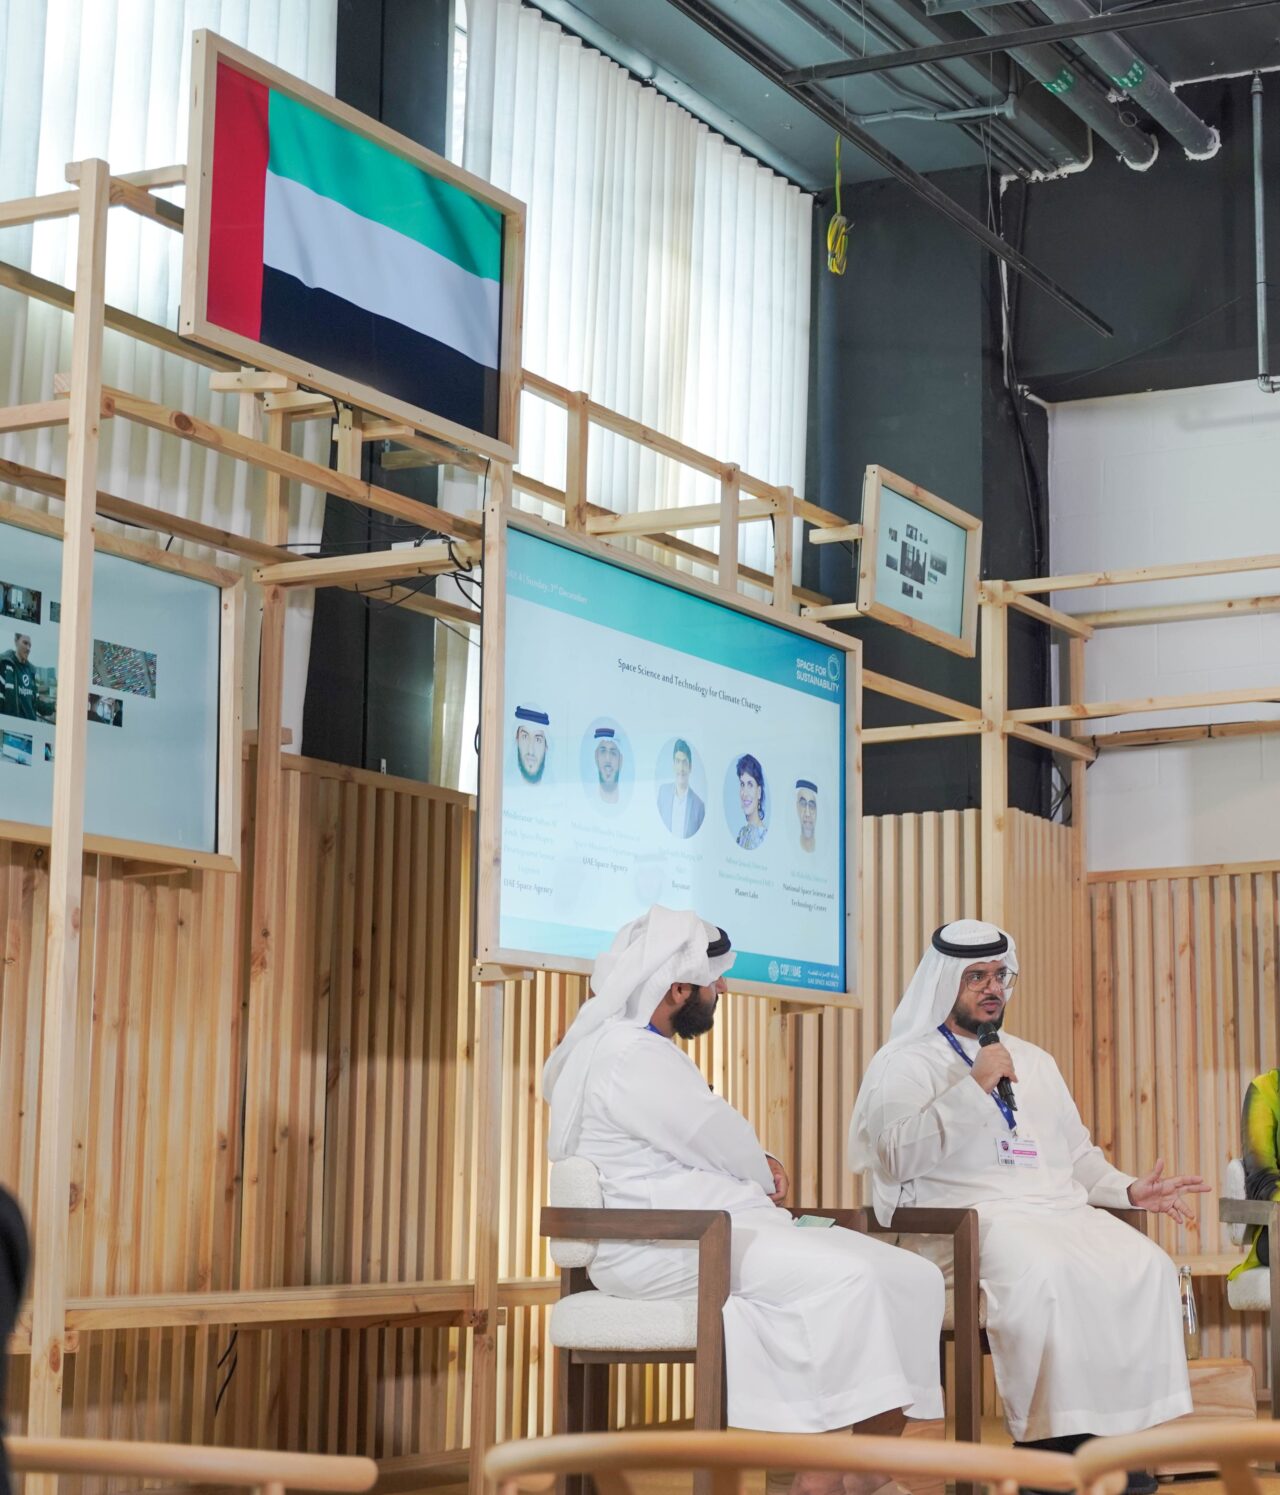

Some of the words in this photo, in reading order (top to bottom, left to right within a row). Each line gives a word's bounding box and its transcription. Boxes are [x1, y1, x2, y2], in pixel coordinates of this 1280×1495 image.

[796, 658, 815, 673] SPACE
[815, 665, 827, 677] FOR
[617, 658, 637, 673] Space
[637, 664, 661, 680] Science
[661, 674, 674, 685] and
[674, 676, 708, 699] Technology
[709, 686, 718, 698] for
[718, 690, 740, 706] Climate
[741, 697, 762, 713] Change
[796, 670, 840, 693] SUSTAINABILITY
[594, 858, 610, 871] Space
[610, 862, 628, 873] Agency
[516, 880, 532, 892] Space
[533, 883, 554, 896] Agency
[782, 883, 801, 894] National
